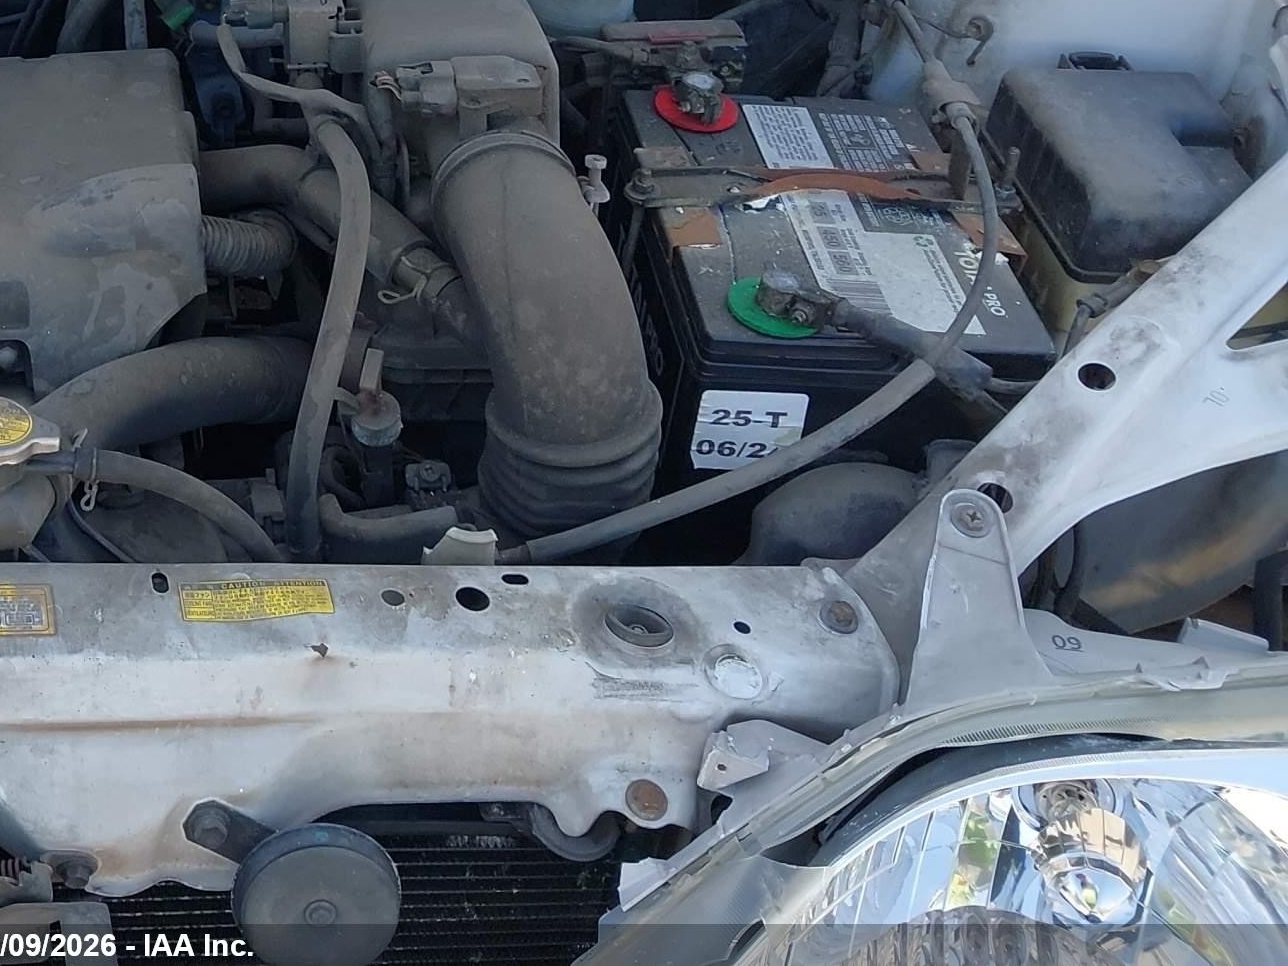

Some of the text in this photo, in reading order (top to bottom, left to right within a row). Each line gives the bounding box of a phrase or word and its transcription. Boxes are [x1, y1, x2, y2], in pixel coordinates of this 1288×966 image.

[823, 229, 841, 247] 450
[833, 253, 851, 273] 560
[983, 292, 1007, 317] PRO
[710, 409, 789, 429] 25-T
[695, 439, 779, 459] 06/2
[221, 581, 265, 590] CAUTION
[1052, 634, 1082, 650] 09
